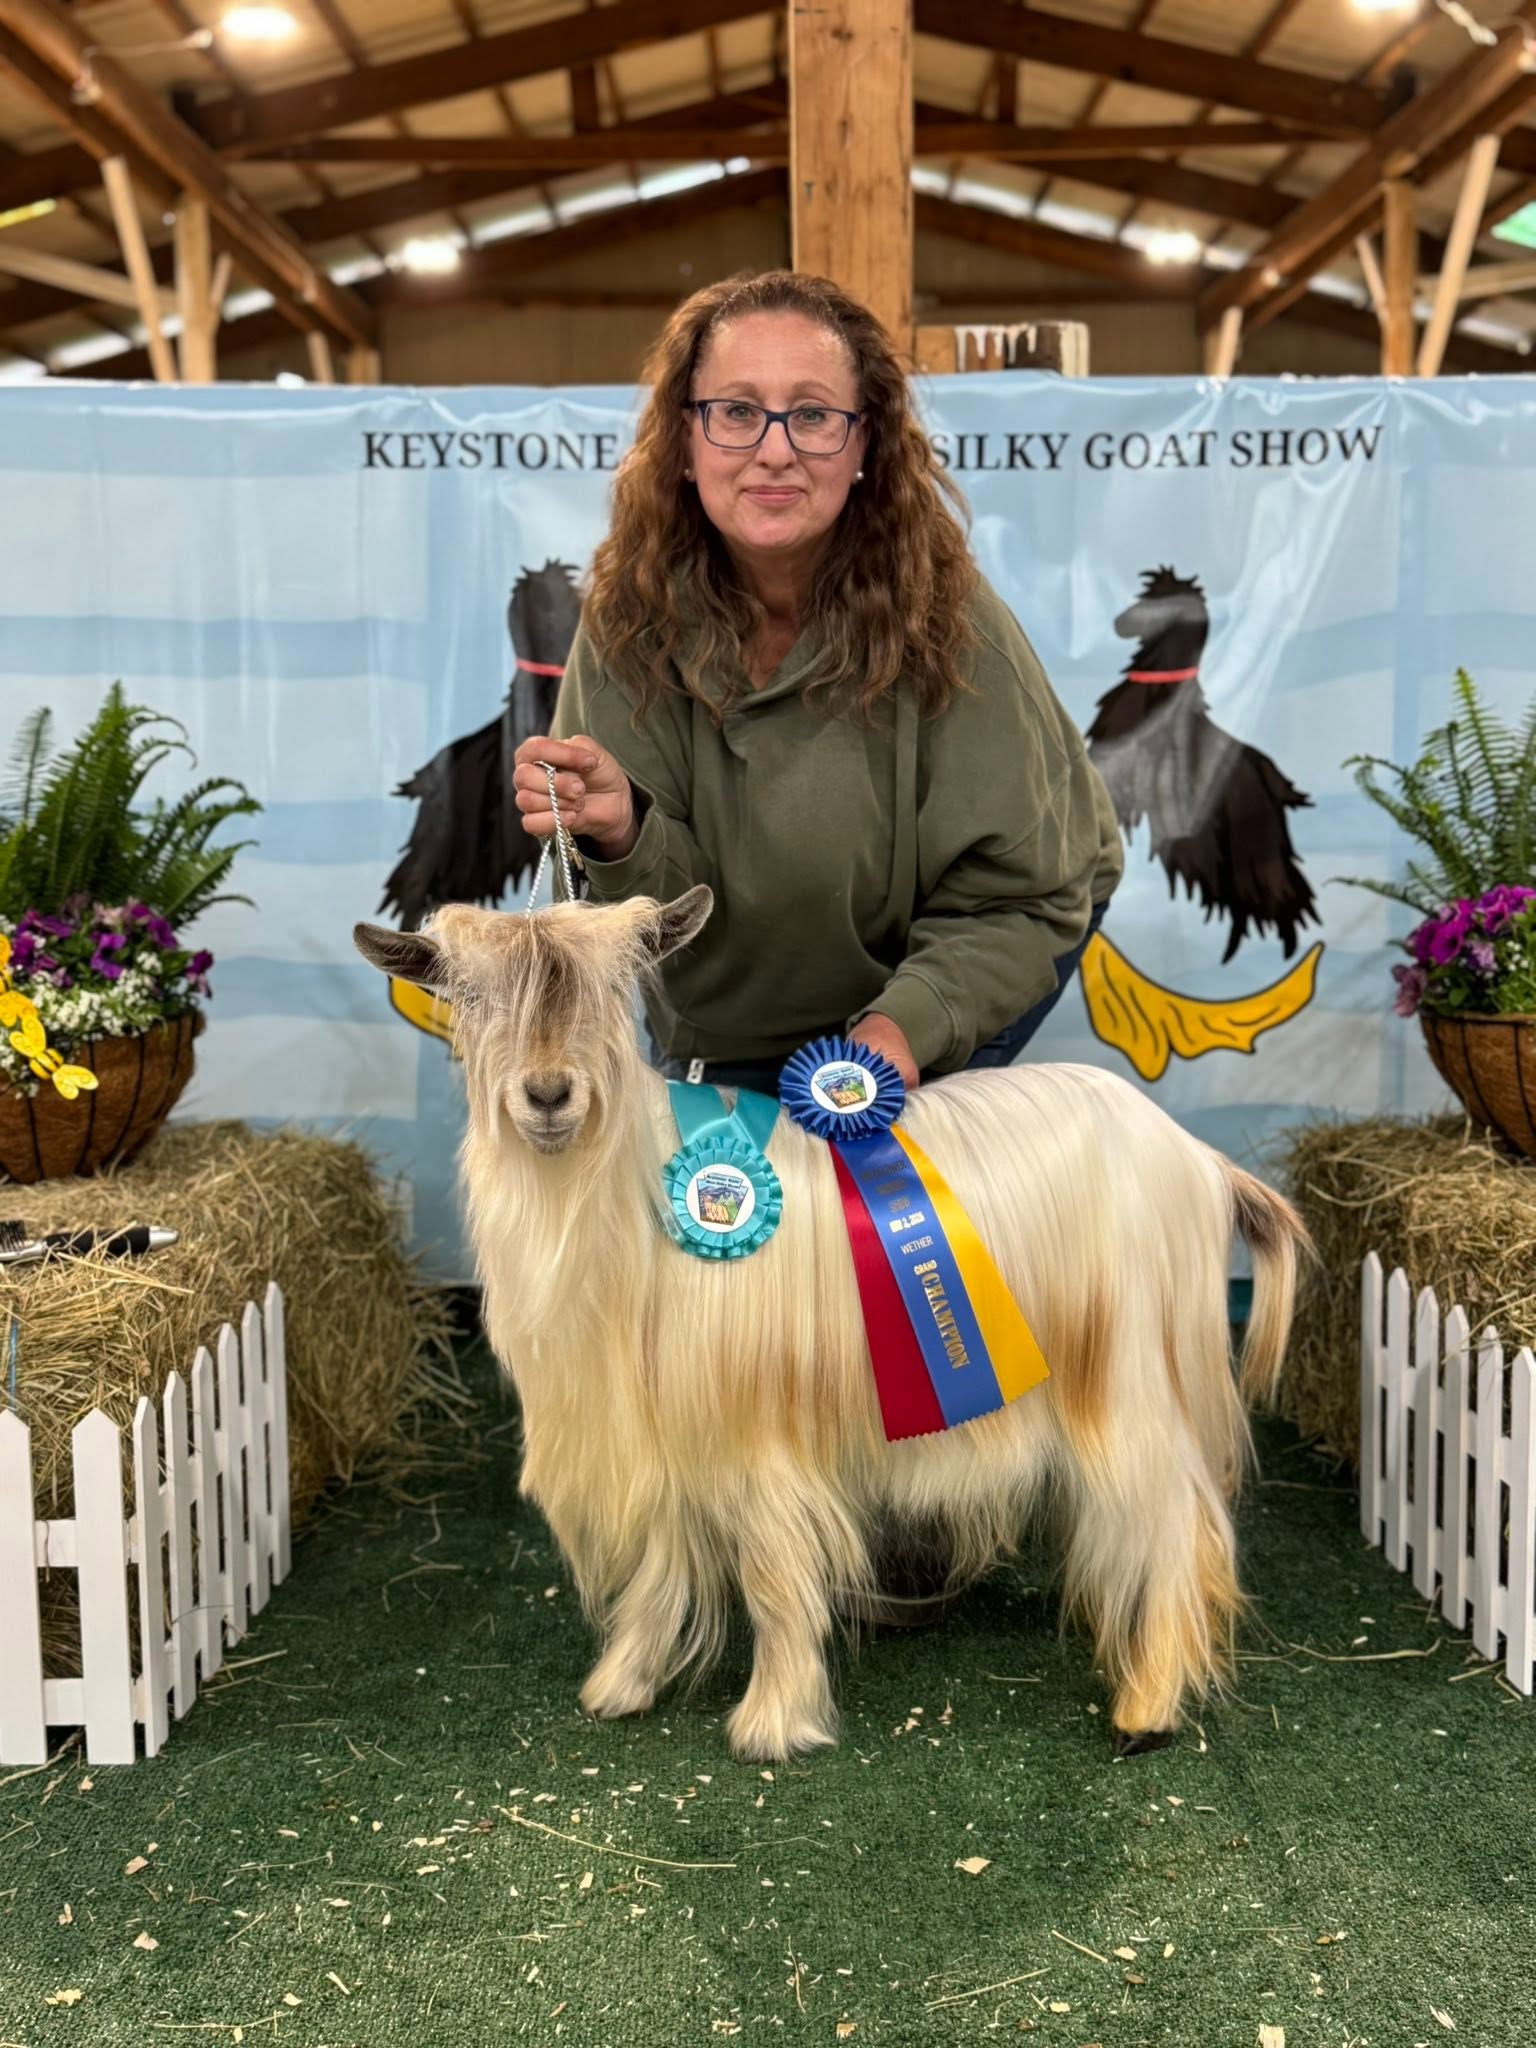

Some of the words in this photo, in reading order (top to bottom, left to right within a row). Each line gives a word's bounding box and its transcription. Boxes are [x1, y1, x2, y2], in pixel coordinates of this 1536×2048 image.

[362, 431, 619, 471] KEYSTONE
[931, 433, 1070, 471] SILKY
[1084, 431, 1218, 470] GOAT
[1229, 425, 1385, 468] SHOW
[901, 1236, 933, 1255] WETHER
[914, 1260, 937, 1275] GRAND
[922, 1273, 970, 1369] CHAMPION
